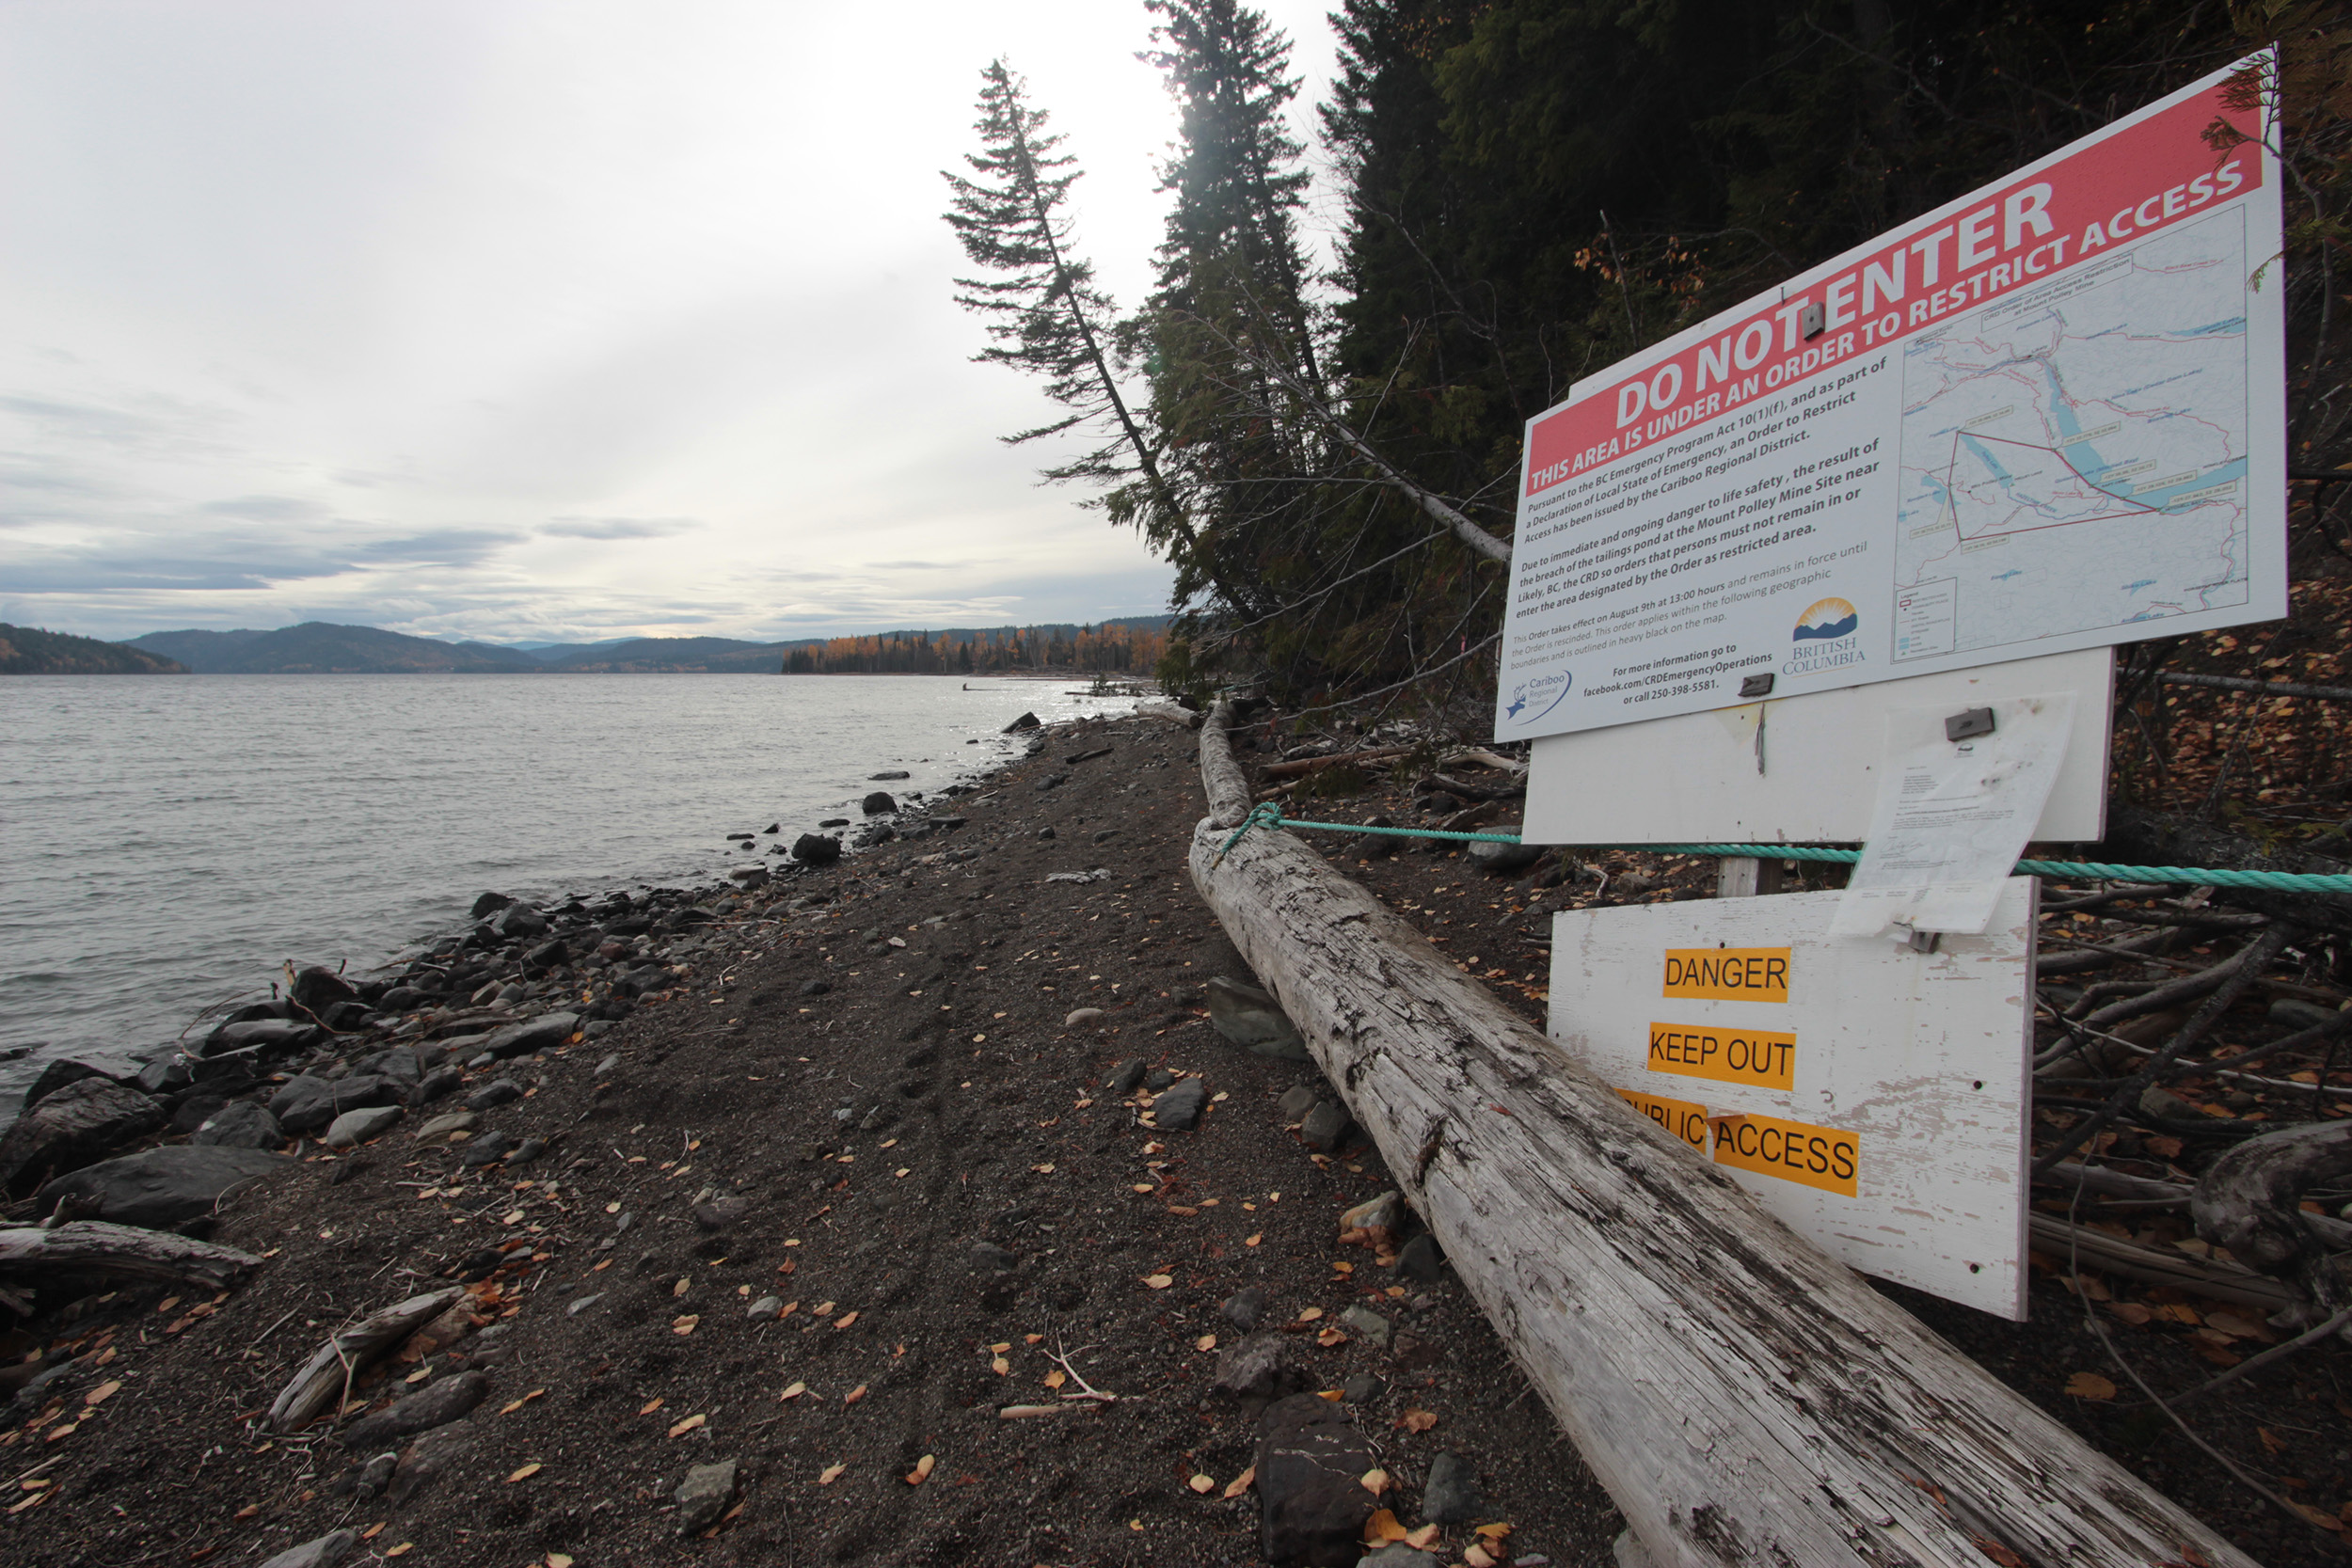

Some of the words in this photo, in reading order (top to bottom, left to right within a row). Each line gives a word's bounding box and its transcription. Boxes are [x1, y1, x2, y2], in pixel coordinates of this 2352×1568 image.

[1531, 458, 1568, 489] THIS
[1571, 436, 1619, 473] AREA
[1624, 426, 1642, 450] IS
[1646, 391, 1720, 439] UNDER
[1724, 372, 1758, 406] AN
[1765, 331, 1853, 387] ORDER
[1861, 311, 1899, 345] TO
[1909, 233, 2070, 326] RESTRICT
[2078, 160, 2241, 254] ACCESS
[1615, 363, 1682, 429] DO
[1695, 295, 1808, 392] NOT
[1824, 182, 2053, 332] ENTER
[1527, 491, 1565, 513] Pursuant
[1566, 488, 1576, 497] to
[1578, 481, 1594, 493] the
[1596, 472, 1608, 486] BC
[1609, 451, 1664, 481] Emergency
[1666, 432, 1713, 457] Program
[1716, 421, 1735, 437] Act
[1739, 400, 1788, 427] 10(1)(f),
[1790, 386, 1816, 406] and
[1819, 381, 1834, 394] as
[1836, 366, 1867, 390] part
[1870, 356, 1886, 372] of
[1533, 501, 1581, 526] Declaration
[1583, 493, 1595, 506] of
[1595, 483, 1620, 501] Local
[1622, 475, 1648, 492] State
[1650, 467, 1661, 481] of
[1663, 444, 1726, 476] Emergency,
[1729, 436, 1744, 449] an
[1747, 420, 1783, 442] Order
[1786, 415, 1799, 426] to
[1803, 390, 1855, 420] Restrict
[1519, 577, 1534, 587] the
[1534, 565, 1565, 582] breach
[1565, 560, 1577, 572] of
[1578, 558, 1593, 569] the
[1595, 545, 1631, 563] tailings
[1633, 532, 1661, 554] pond
[1662, 530, 1674, 542] at
[1676, 524, 1694, 537] the
[1696, 509, 1735, 531] Mount
[1738, 496, 1776, 516] Polley
[1778, 484, 1811, 502] Mine
[1815, 474, 1842, 491] Site
[1845, 461, 1879, 481] near
[1521, 561, 1537, 572] Due
[1539, 557, 1549, 565] to
[1549, 540, 1598, 562] immediate
[1600, 530, 1619, 546] and
[1621, 517, 1663, 538] ongoing
[1665, 502, 1706, 523] danger
[1708, 498, 1720, 508] to
[1723, 488, 1741, 503] life
[1792, 464, 1815, 478] the
[1818, 446, 1859, 469] result
[1863, 436, 1879, 453] of
[1524, 528, 1550, 544] Access
[1552, 521, 1567, 533] has
[1569, 513, 1592, 527] been
[1594, 498, 1625, 518] issued
[1626, 495, 1639, 507] by
[1641, 488, 1658, 500] the
[1660, 471, 1702, 493] Cariboo
[1705, 447, 1756, 477] Regional
[1759, 430, 1810, 456] District.
[1516, 606, 1538, 618] enter
[1540, 601, 1554, 611] the
[1556, 594, 1576, 607] area
[1578, 576, 1632, 600] designated
[1634, 574, 1648, 585] by
[1650, 568, 1667, 580] the
[1670, 558, 1702, 574] Order
[1704, 553, 1716, 564] as
[1719, 531, 1779, 560] restricted
[1782, 524, 1816, 541] area.
[1518, 588, 1545, 603] Likely,
[1547, 581, 1561, 594] BC,
[1563, 578, 1578, 589] the
[1580, 570, 1599, 584] CRD
[1600, 568, 1612, 578] so
[1613, 557, 1645, 574] orders
[1648, 548, 1671, 563] that
[1673, 534, 1717, 559] persons
[1720, 523, 1750, 541] must
[1753, 515, 1774, 531] not
[1777, 499, 1824, 523] remain
[1828, 494, 1841, 506] in
[1845, 488, 1861, 500] or
[1512, 648, 1523, 657] the
[1524, 642, 1546, 654] Order
[1547, 640, 1552, 648] is
[1553, 630, 1592, 646] rescinded.
[1595, 626, 1611, 637] This
[1613, 620, 1636, 632] order
[1637, 612, 1668, 626] applies
[1670, 604, 1699, 617] within
[1702, 599, 1718, 610] the
[1721, 586, 1767, 605] following
[1769, 568, 1831, 594] geographic
[1513, 635, 1527, 643] This
[1528, 629, 1549, 640] Order
[1550, 624, 1570, 634] takes
[1572, 617, 1595, 629] effect
[1597, 614, 1607, 623] on
[1609, 605, 1639, 620] August
[1640, 600, 1655, 611] 9th
[1657, 597, 1666, 607] at
[1669, 589, 1695, 604] 13:00
[1697, 582, 1724, 596] hours
[1727, 575, 1746, 588] and
[1749, 564, 1790, 582] remains
[1794, 561, 1804, 570] in
[1807, 551, 1836, 565] force
[1839, 540, 1867, 557] until
[1510, 655, 1549, 670] boundaries
[1550, 649, 1565, 660] and
[1565, 648, 1572, 657] is
[1574, 640, 1607, 655] outlined
[1608, 639, 1616, 647] in
[1618, 633, 1644, 644] heavy
[1645, 625, 1668, 639] black
[1670, 624, 1682, 632] on
[1684, 619, 1700, 629] the
[1702, 613, 1726, 625] map.
[1583, 653, 1772, 696] facebook.com/CRDEmergencyOperations
[1613, 667, 1627, 676] For
[1628, 662, 1651, 673] more
[1652, 650, 1708, 668] information
[1710, 647, 1724, 658] go
[1725, 644, 1736, 653] to
[1782, 650, 1865, 674] COLUMBIA
[1792, 637, 1855, 660] BRITISH
[1528, 685, 1557, 699] Regional
[1529, 674, 1565, 688] Cariboo
[1633, 690, 1649, 702] call
[1650, 679, 1719, 699] 250-398-5581.
[1665, 958, 1787, 990] DANGER
[1649, 1031, 1718, 1066] KEEP
[1727, 1038, 1793, 1076] OUT
[1715, 1121, 1854, 1180] ACCESS
